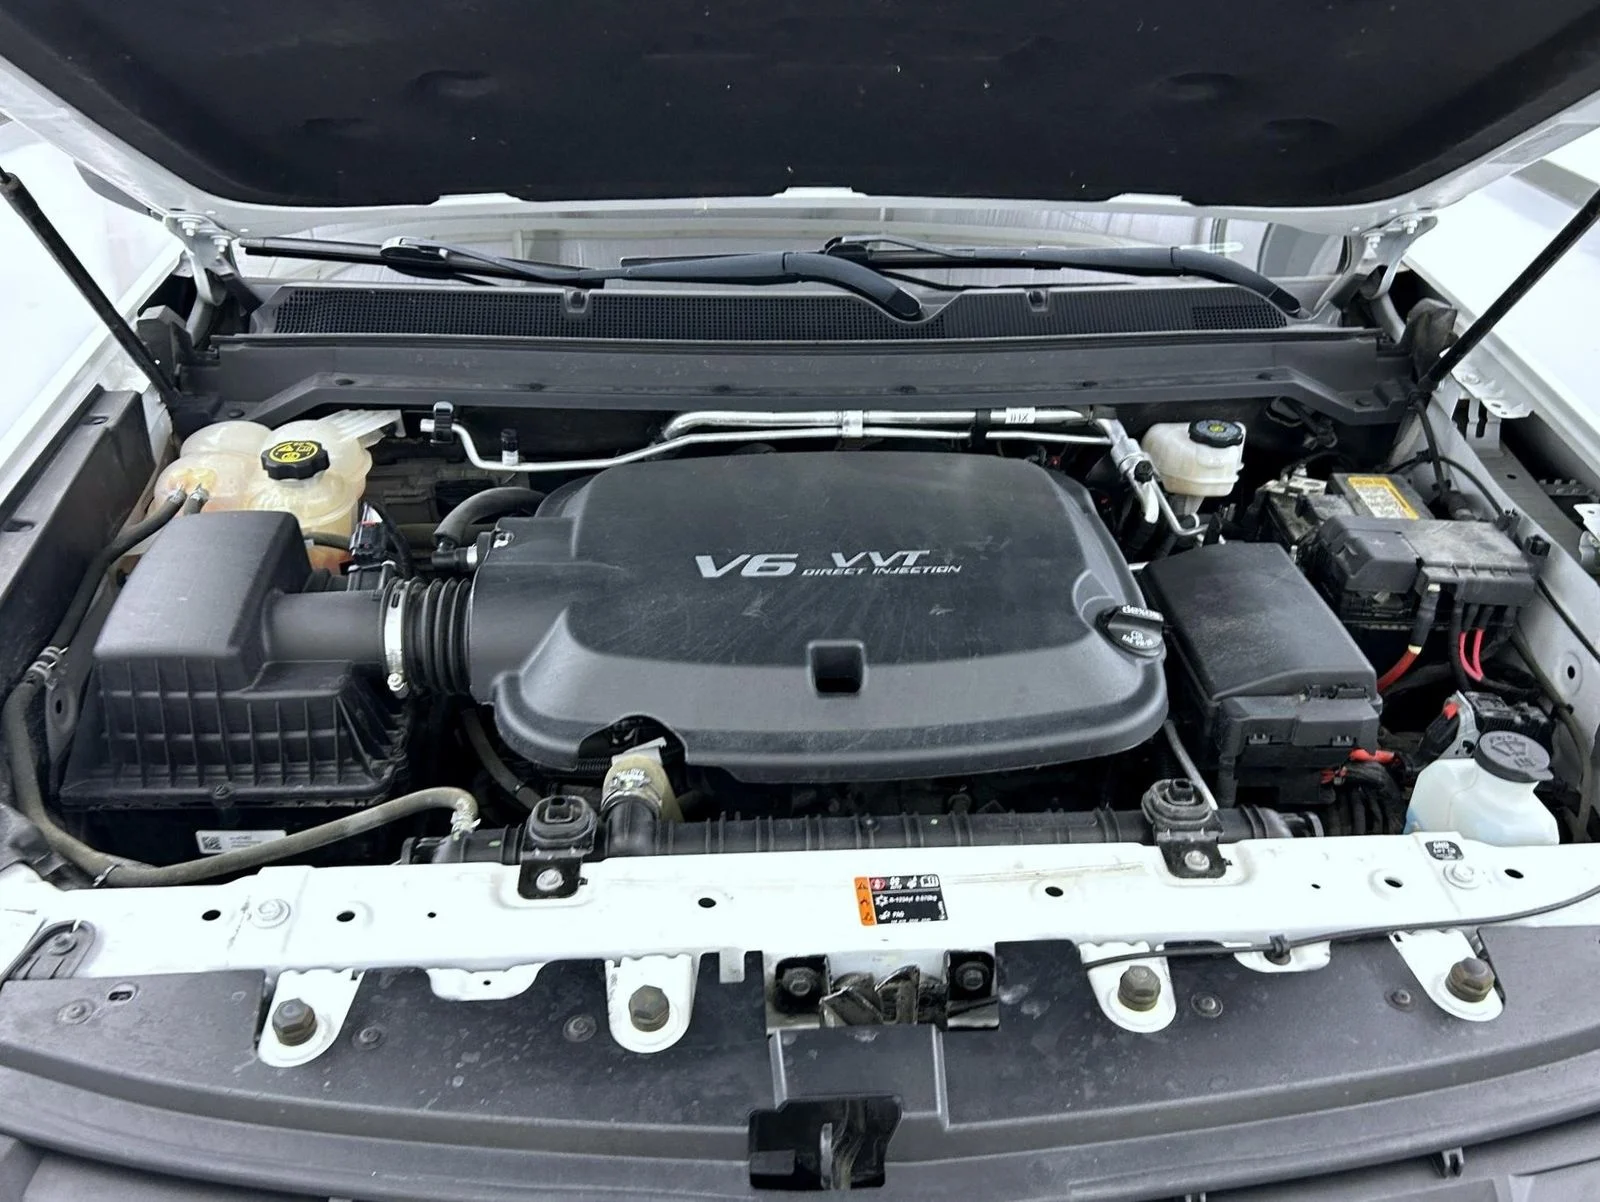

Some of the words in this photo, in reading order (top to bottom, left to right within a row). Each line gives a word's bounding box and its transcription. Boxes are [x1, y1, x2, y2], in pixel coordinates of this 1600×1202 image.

[695, 553, 799, 578] V6
[831, 550, 930, 568] VVT
[801, 567, 867, 577] DIRECT
[872, 564, 962, 576] INJECTION
